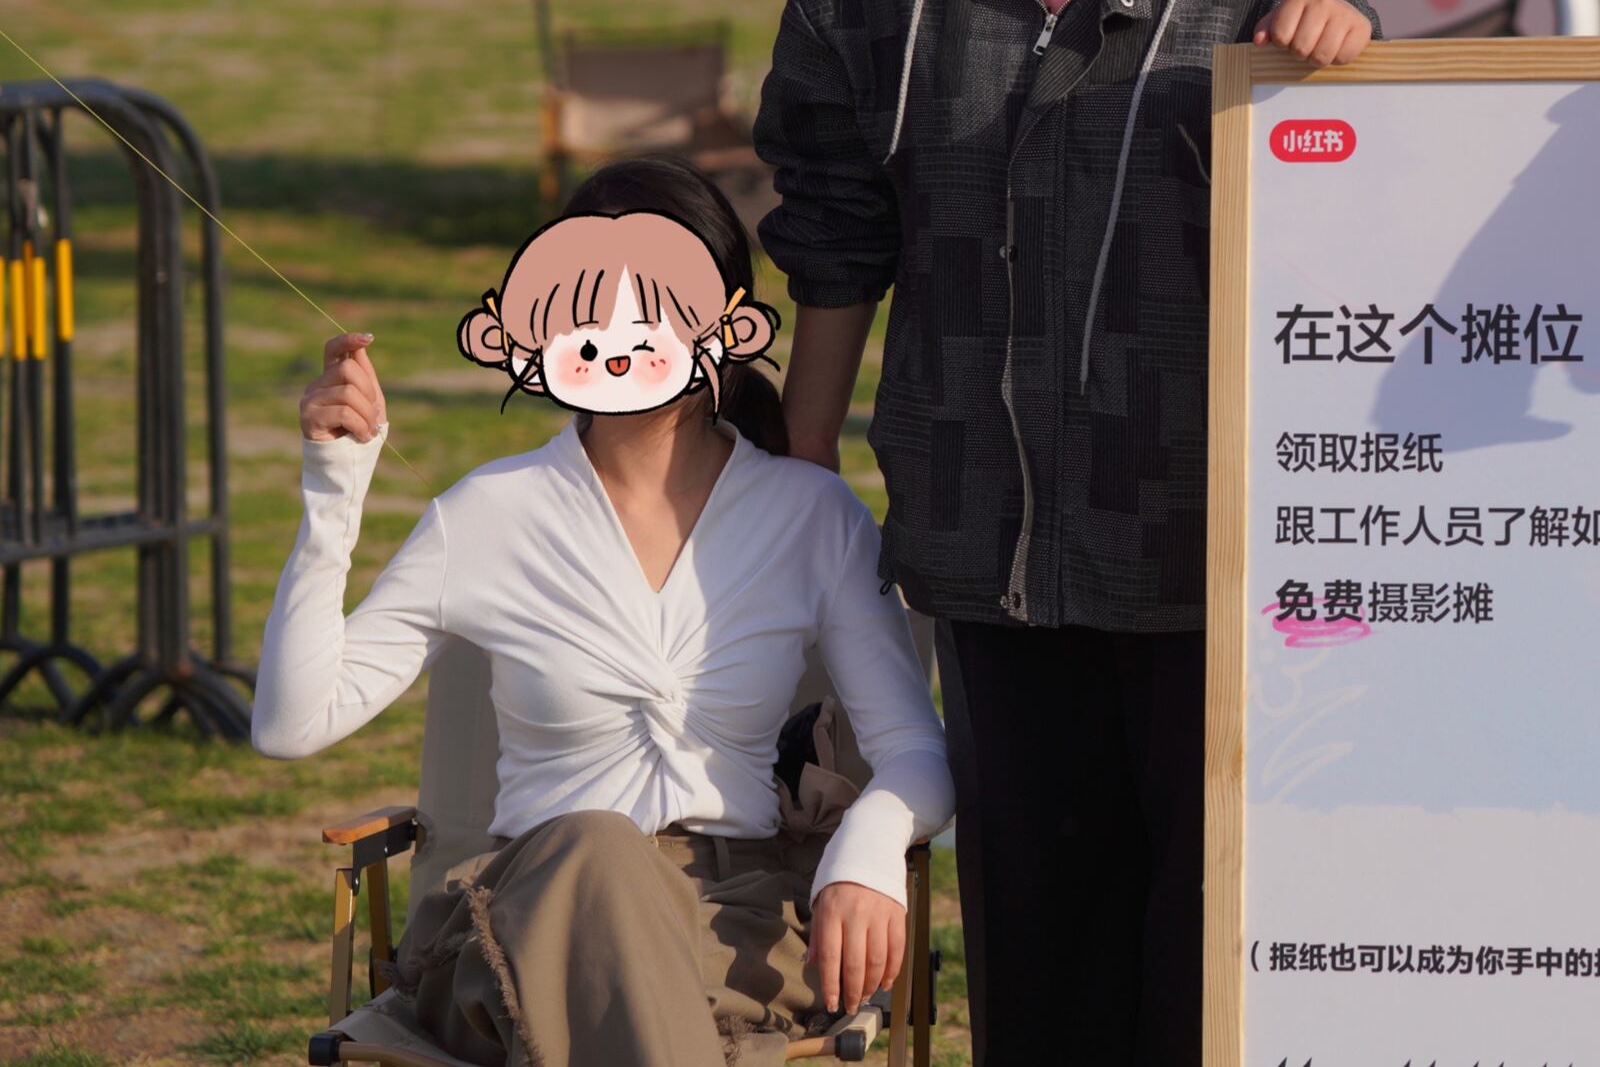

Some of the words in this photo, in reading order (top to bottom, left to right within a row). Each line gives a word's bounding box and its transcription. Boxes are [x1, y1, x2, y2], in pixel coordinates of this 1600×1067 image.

[1283, 129, 1344, 153] 小红书
[1274, 303, 1584, 365] 在这个摊位
[1275, 432, 1443, 473] 领取报纸
[1275, 579, 1493, 624] 免费摄影摊
